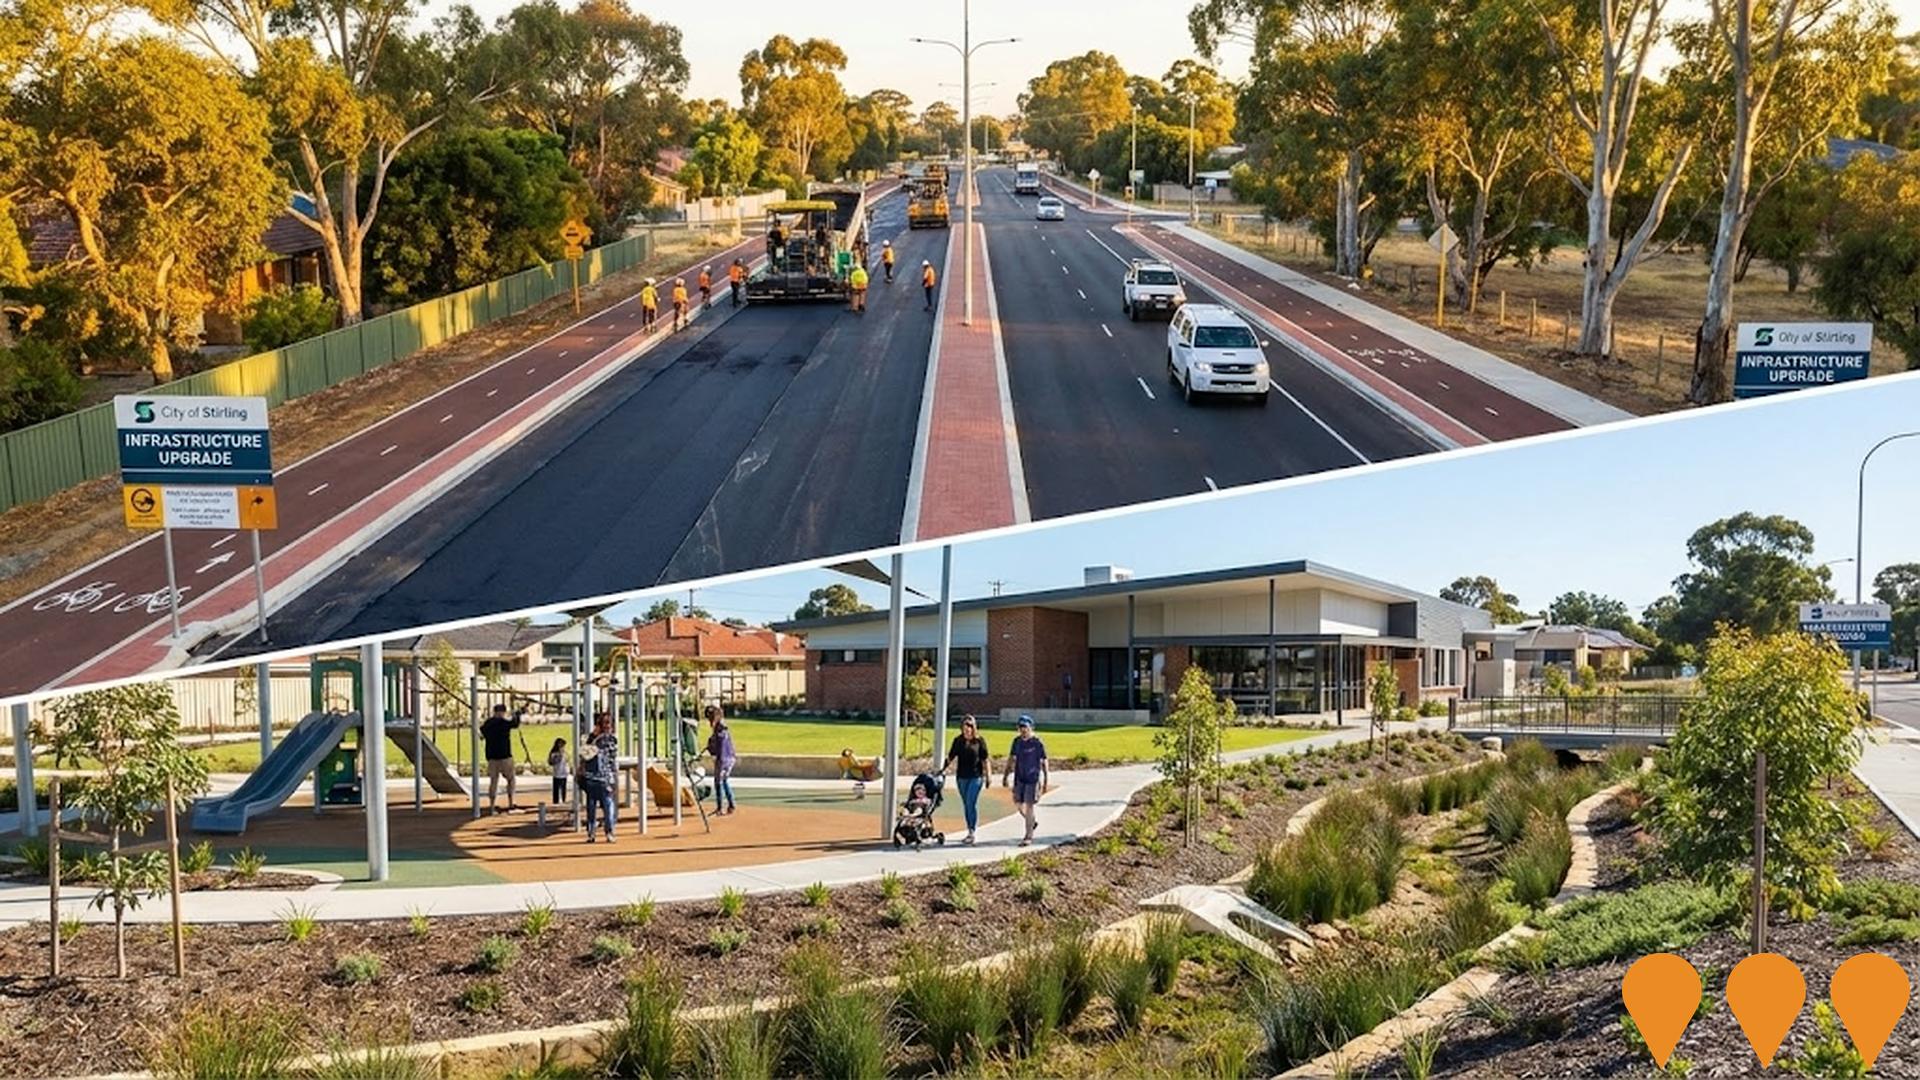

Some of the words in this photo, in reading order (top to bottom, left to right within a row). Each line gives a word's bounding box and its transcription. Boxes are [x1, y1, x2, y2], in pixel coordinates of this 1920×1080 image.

[1769, 370, 1834, 382] UPGRADE
[161, 406, 184, 421] City
[187, 406, 200, 418] of
[202, 407, 248, 420] Stirling
[125, 434, 262, 448] INFRASTRUCTURE
[159, 452, 232, 465] UPGRADE
